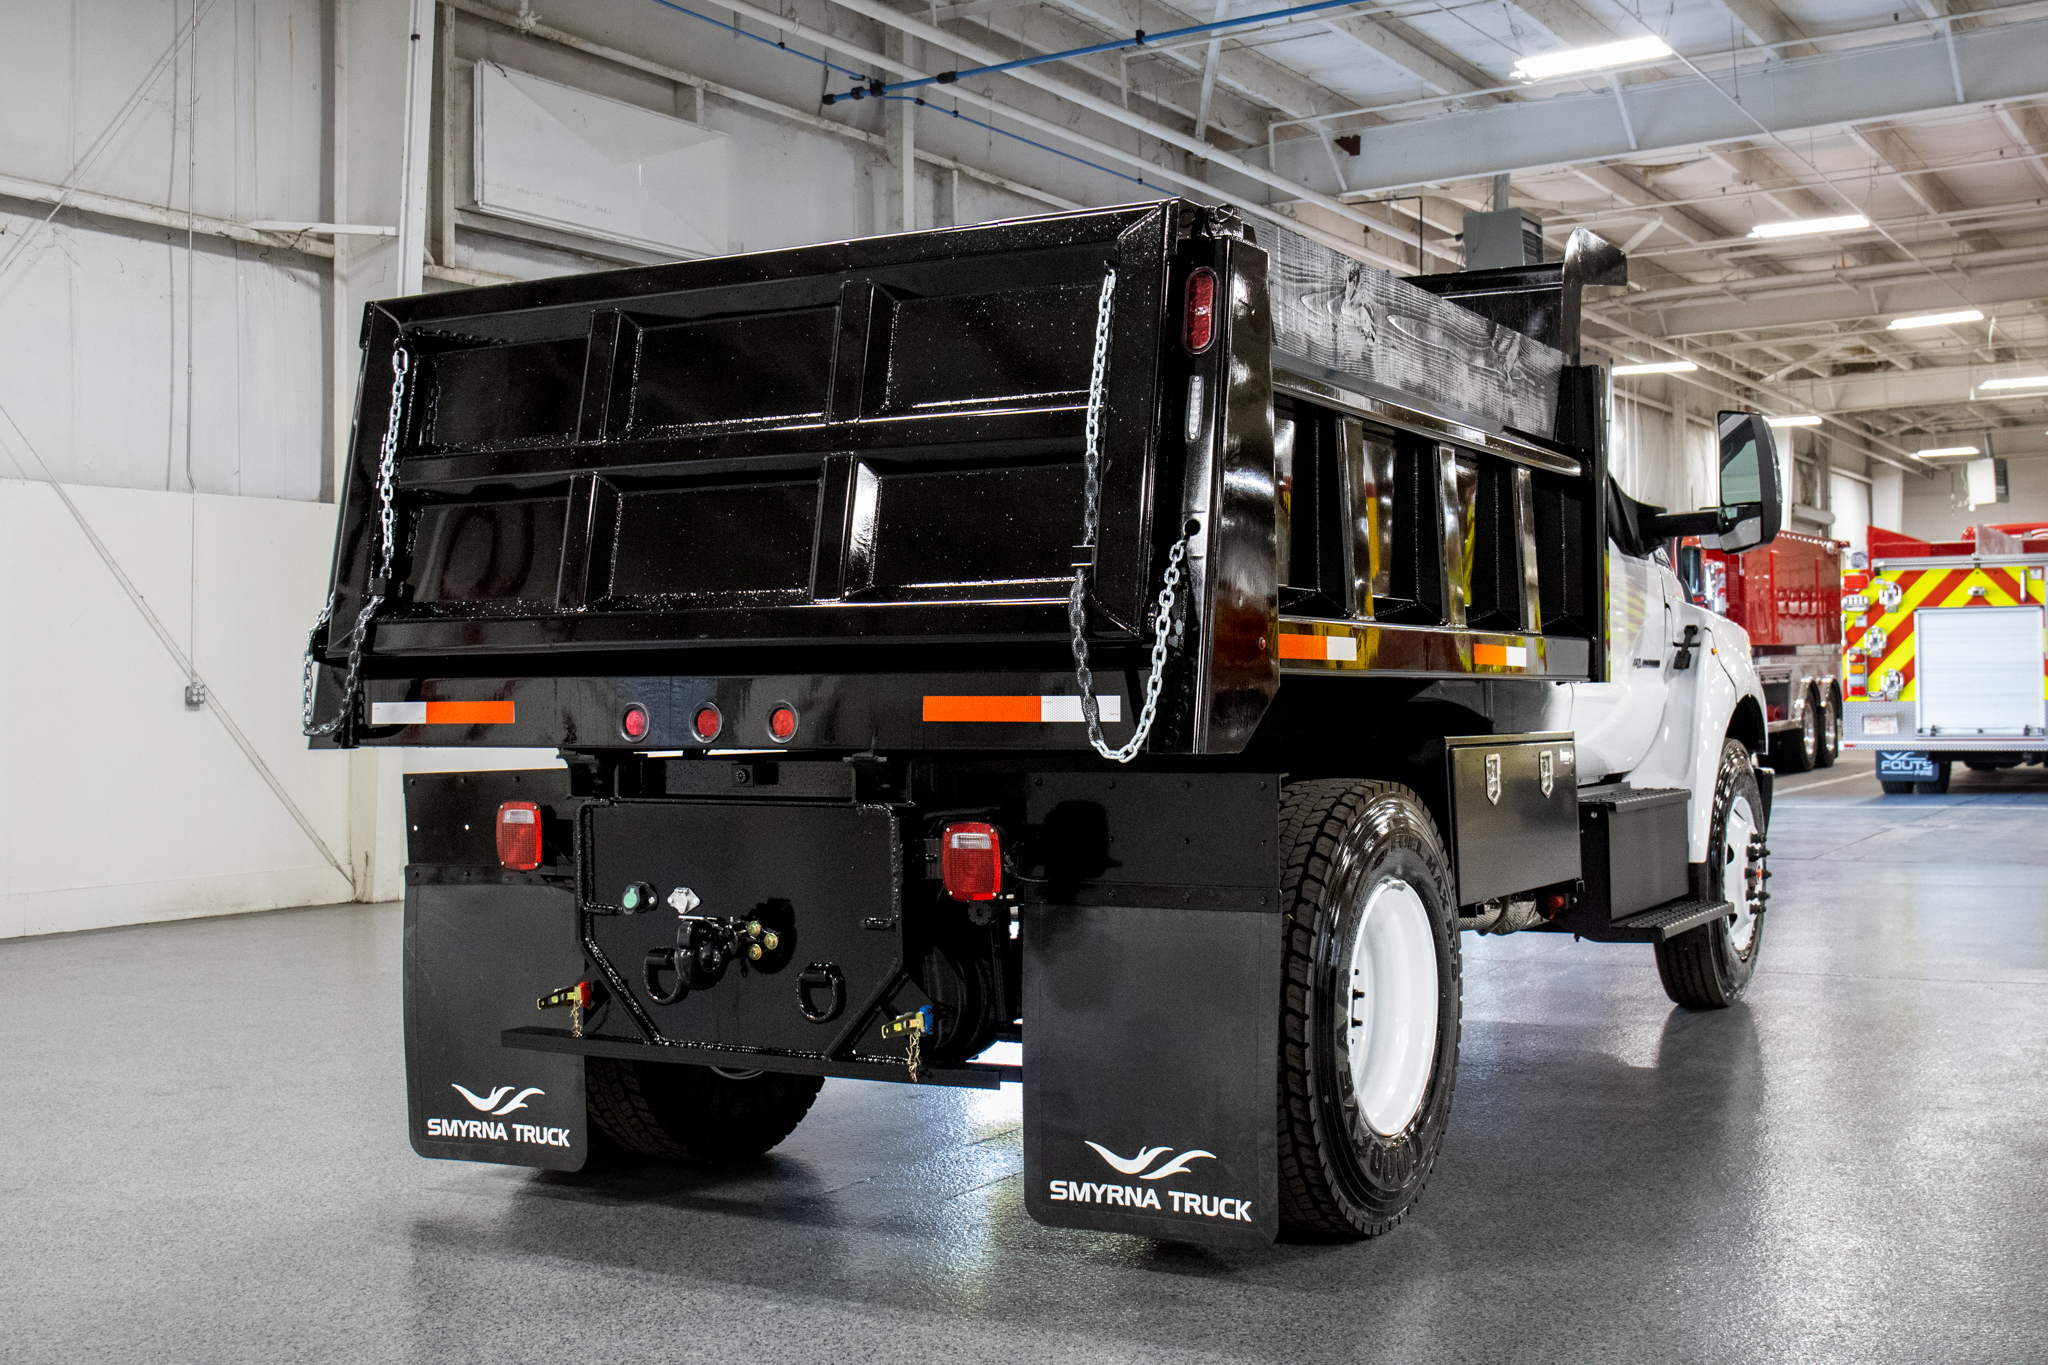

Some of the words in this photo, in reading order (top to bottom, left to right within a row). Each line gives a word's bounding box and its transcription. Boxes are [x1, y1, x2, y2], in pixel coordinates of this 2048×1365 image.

[594, 205, 613, 215] THE
[1881, 760, 1933, 770] FOUTS
[1390, 834, 1424, 860] FUEL
[1425, 854, 1449, 911] MAX
[427, 1118, 508, 1140] SMYRNA
[512, 1123, 570, 1147] TRUCK
[1050, 1179, 1161, 1210] SMYRNA
[1168, 1190, 1252, 1222] TRUCK
